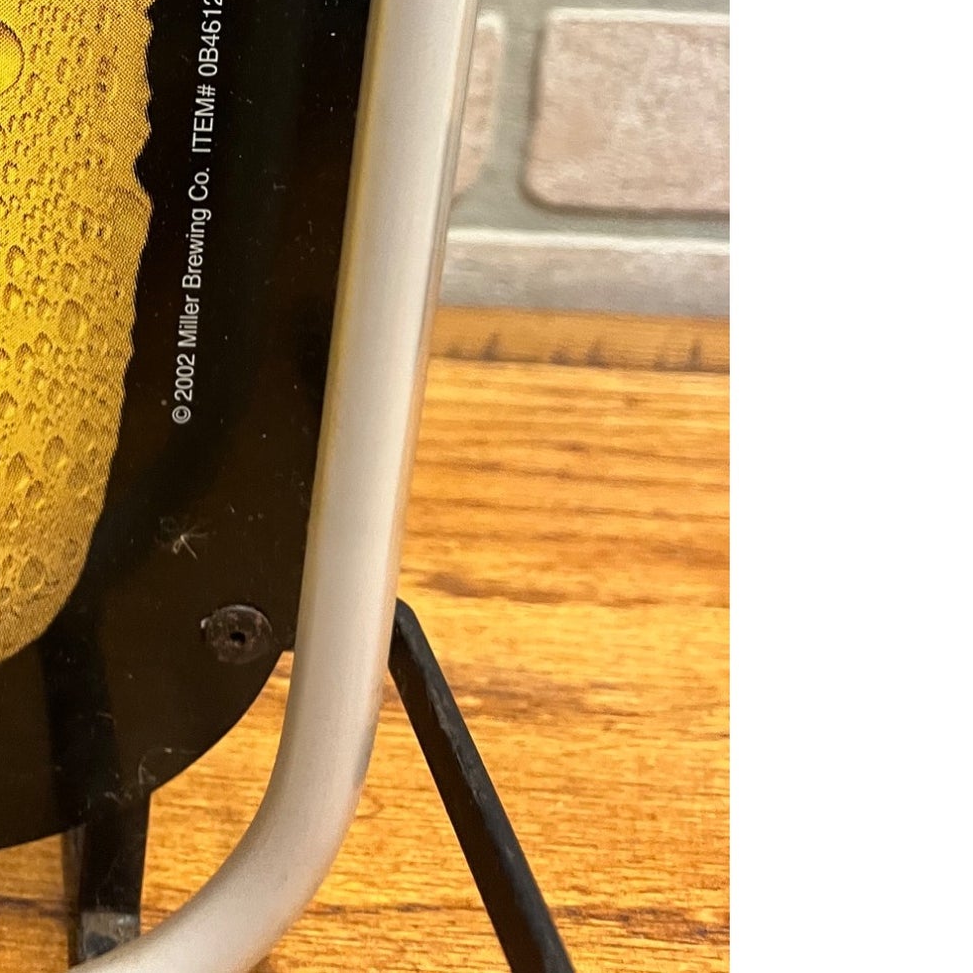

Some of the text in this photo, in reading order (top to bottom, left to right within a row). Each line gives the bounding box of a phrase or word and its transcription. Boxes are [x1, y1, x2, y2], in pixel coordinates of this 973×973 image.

[191, 84, 216, 153] ITEM#
[188, 167, 210, 201] Co.
[182, 208, 212, 289] Brewing
[177, 294, 200, 348] Miller
[174, 353, 196, 402] 2002
